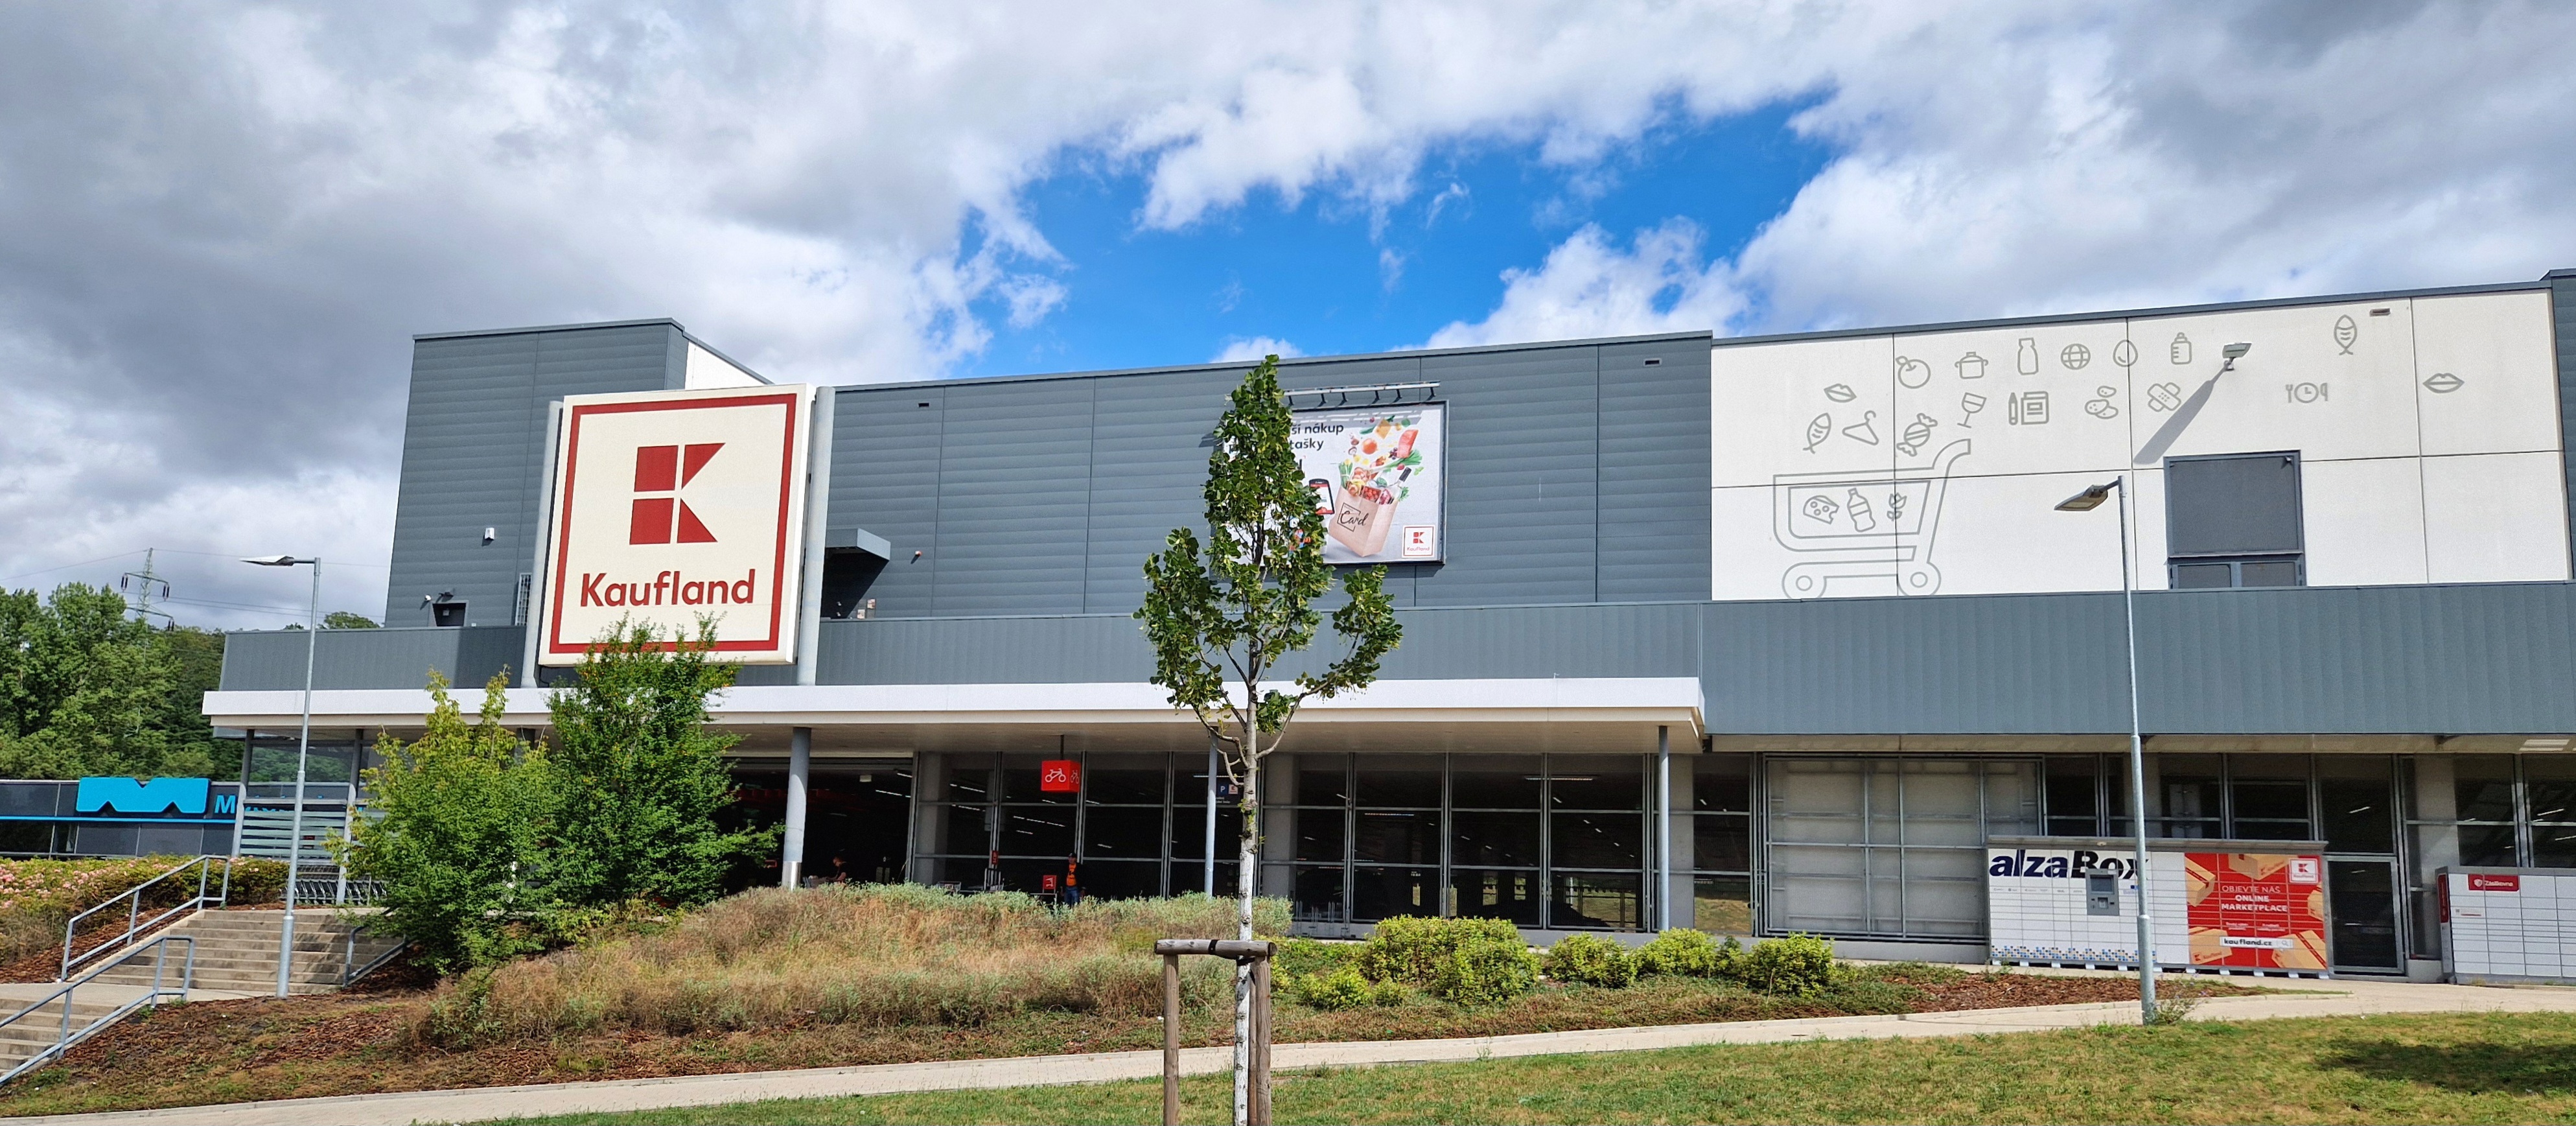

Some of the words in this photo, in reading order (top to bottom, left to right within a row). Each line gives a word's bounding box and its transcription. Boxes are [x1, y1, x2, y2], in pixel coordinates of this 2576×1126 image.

[1305, 423, 1344, 436] nákup
[1290, 438, 1324, 451] tašky
[1340, 510, 1369, 526] Card
[581, 569, 755, 607] Kaufland
[2221, 904, 2288, 912] MARKETPLACE
